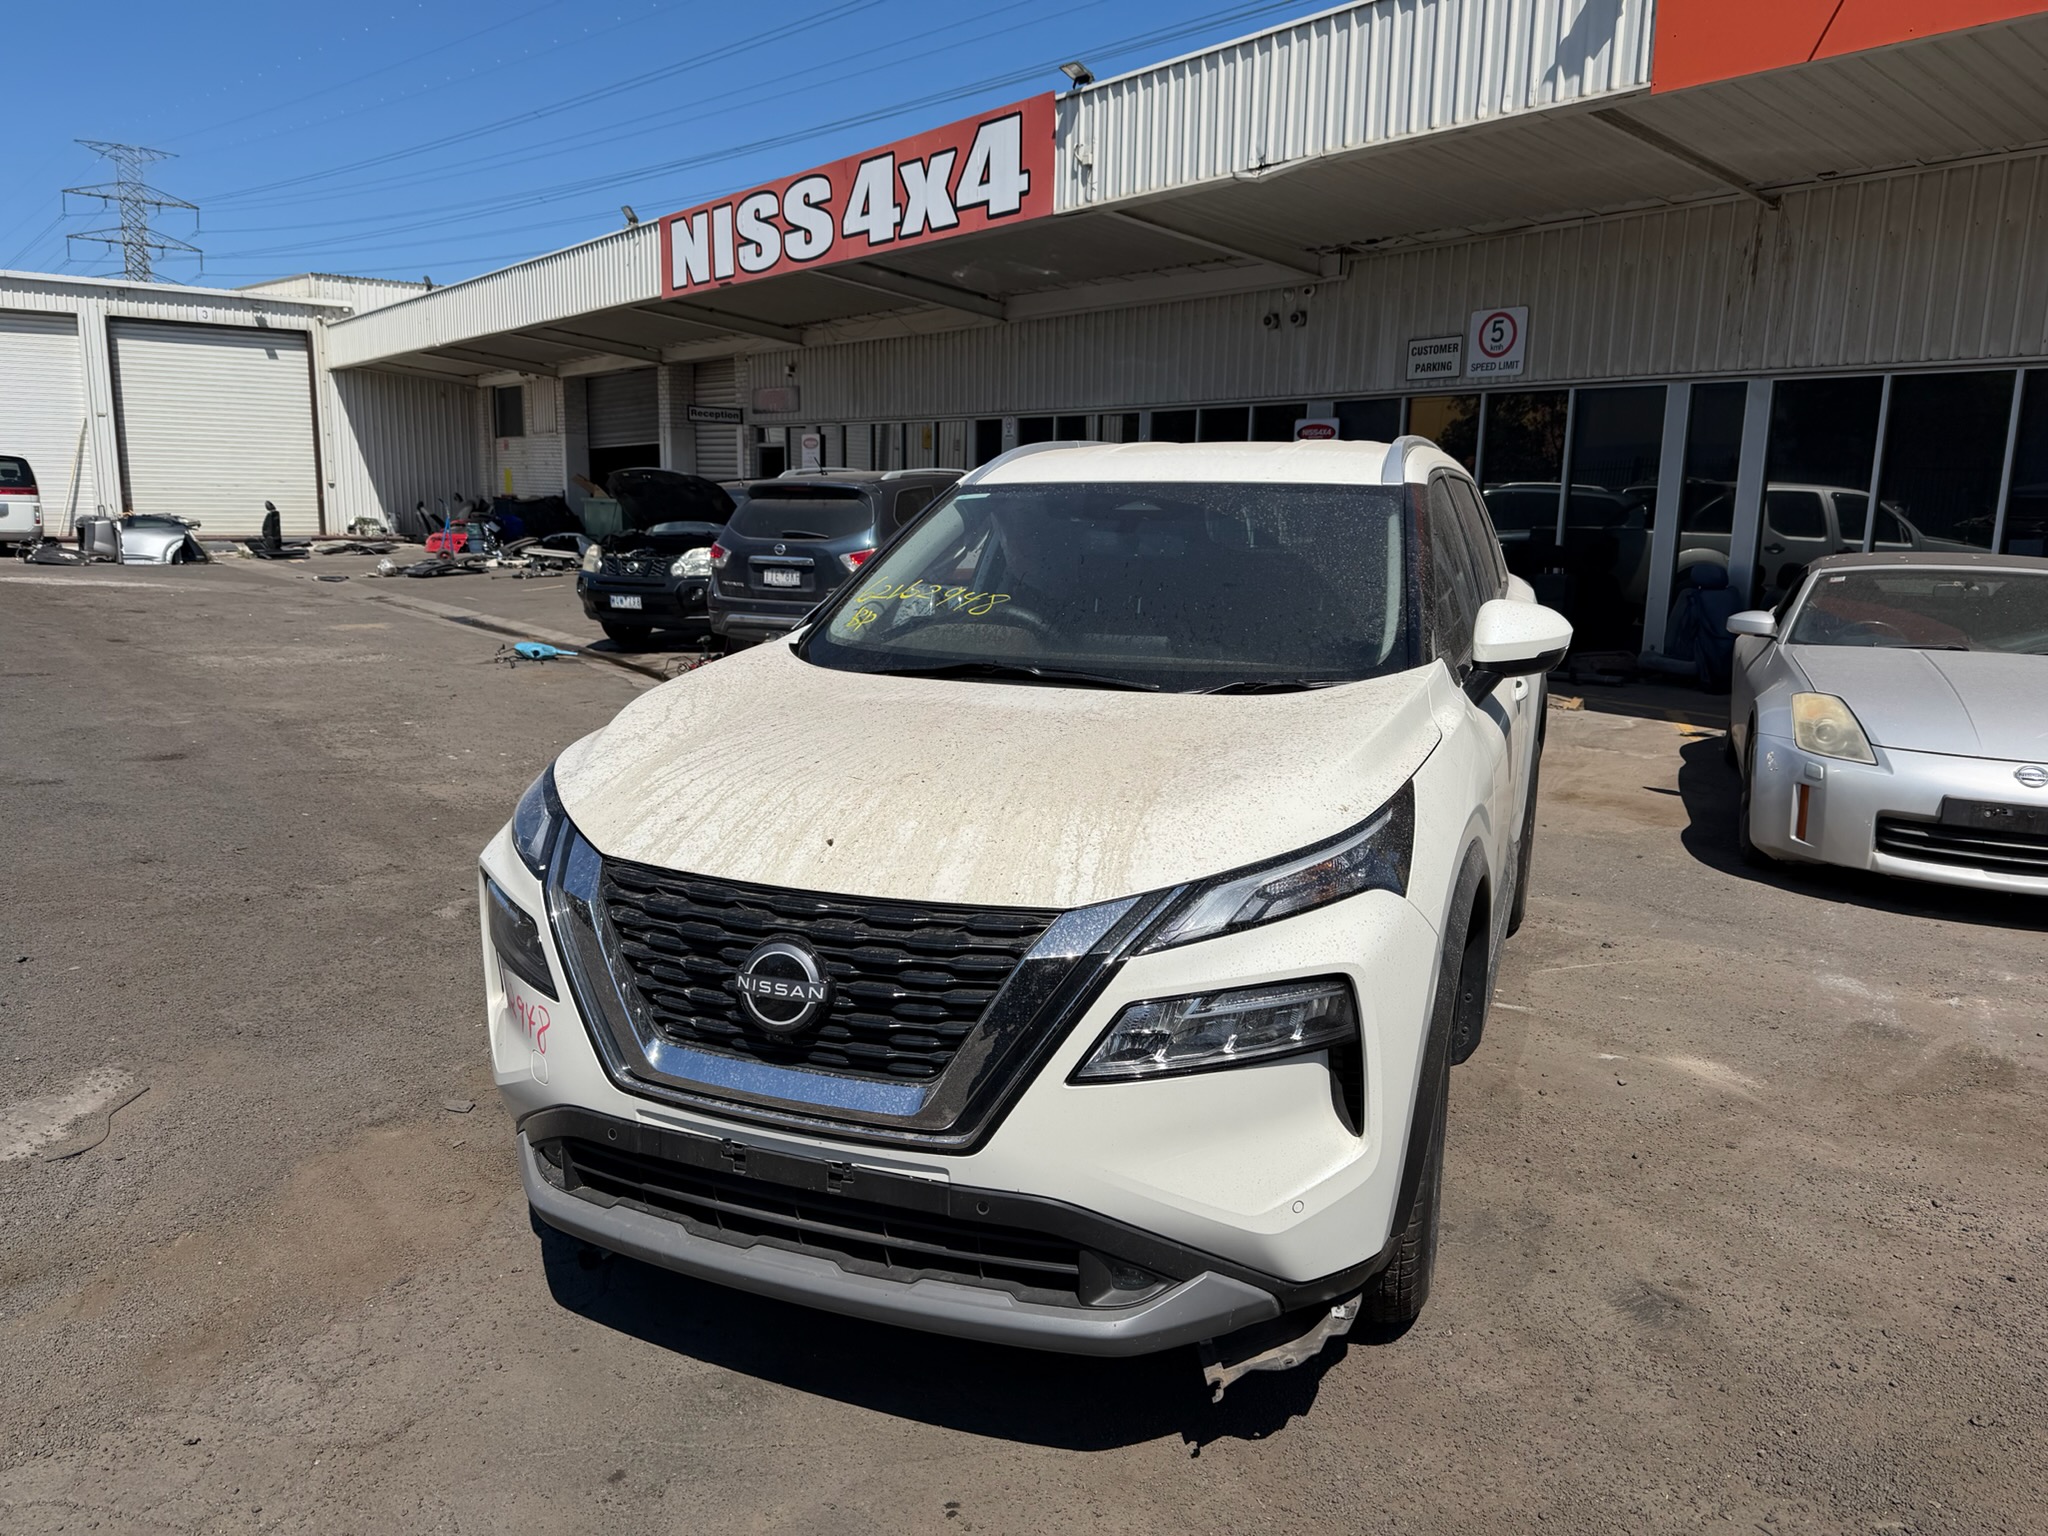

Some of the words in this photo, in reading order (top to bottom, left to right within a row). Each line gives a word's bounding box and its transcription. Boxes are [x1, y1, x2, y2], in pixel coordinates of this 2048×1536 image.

[671, 174, 834, 290] NISS
[202, 310, 208, 319] 3
[1491, 319, 1504, 343] 5
[1411, 343, 1459, 357] CUSTOMER
[1490, 343, 1504, 352] kmh
[1415, 361, 1452, 373] PARKING
[1471, 361, 1497, 372] SPEED
[1498, 360, 1520, 370] LIMIT
[690, 408, 740, 420] Reception
[737, 975, 824, 1000] NISSAN
